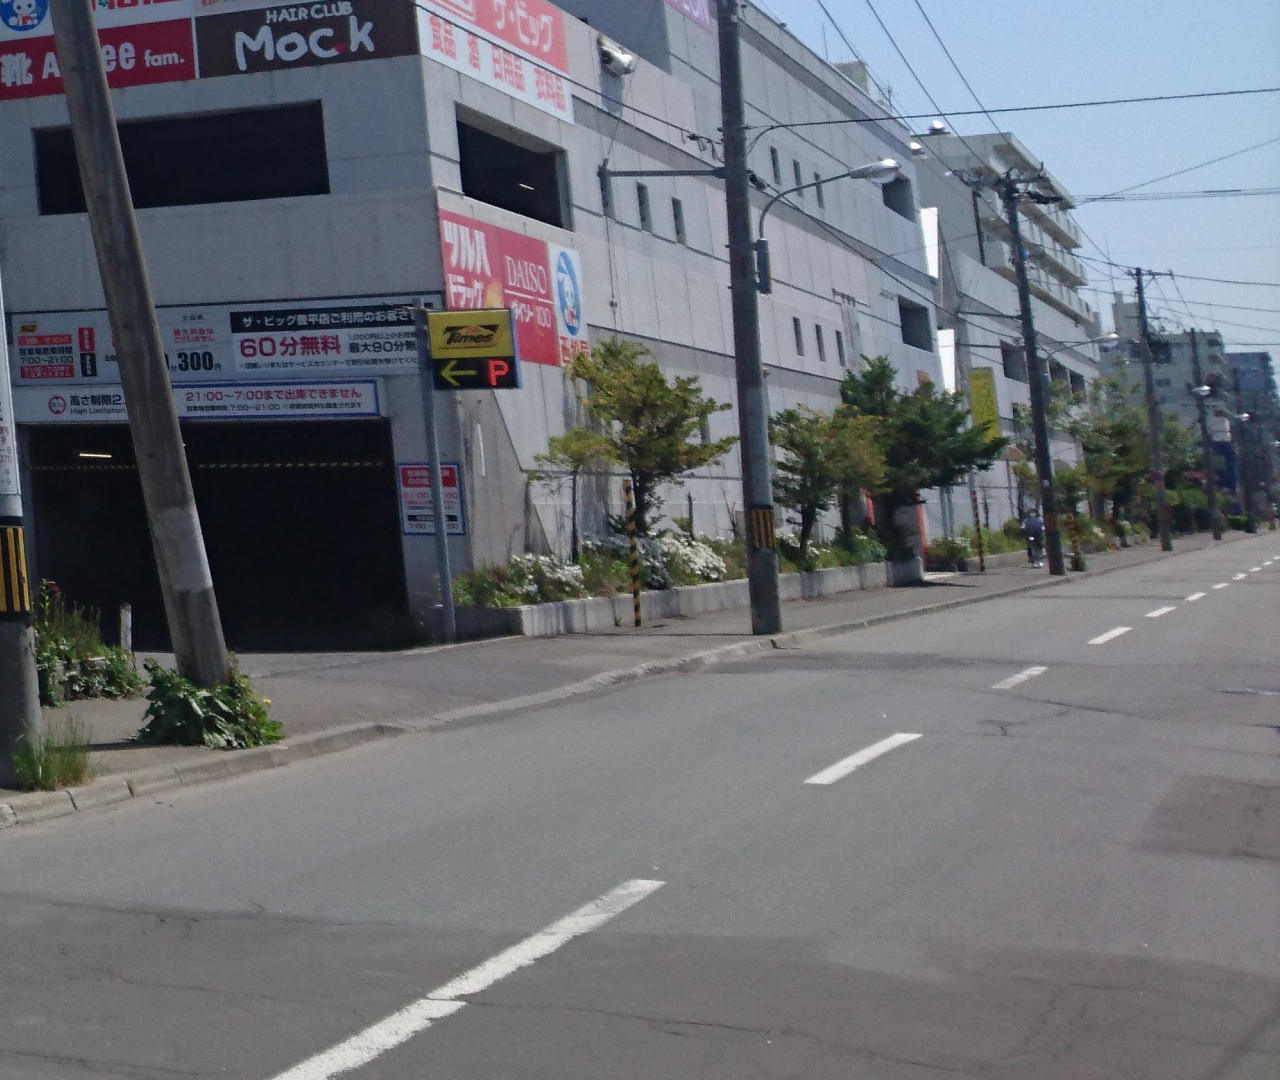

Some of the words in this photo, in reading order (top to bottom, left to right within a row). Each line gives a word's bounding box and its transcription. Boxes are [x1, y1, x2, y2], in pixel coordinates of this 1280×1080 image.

[266, 8, 308, 24] HAIR
[310, 1, 353, 19] CLUB
[0, 51, 33, 87] 靴
[42, 41, 136, 80] Aee
[144, 49, 185, 68] fam.
[443, 219, 491, 278] ツルハ
[505, 255, 547, 295] DAISO
[448, 273, 484, 308] ドラッグ
[536, 306, 552, 329] 100
[239, 334, 341, 358] 60分無料
[489, 360, 509, 386] P
[70, 407, 88, 415] High
